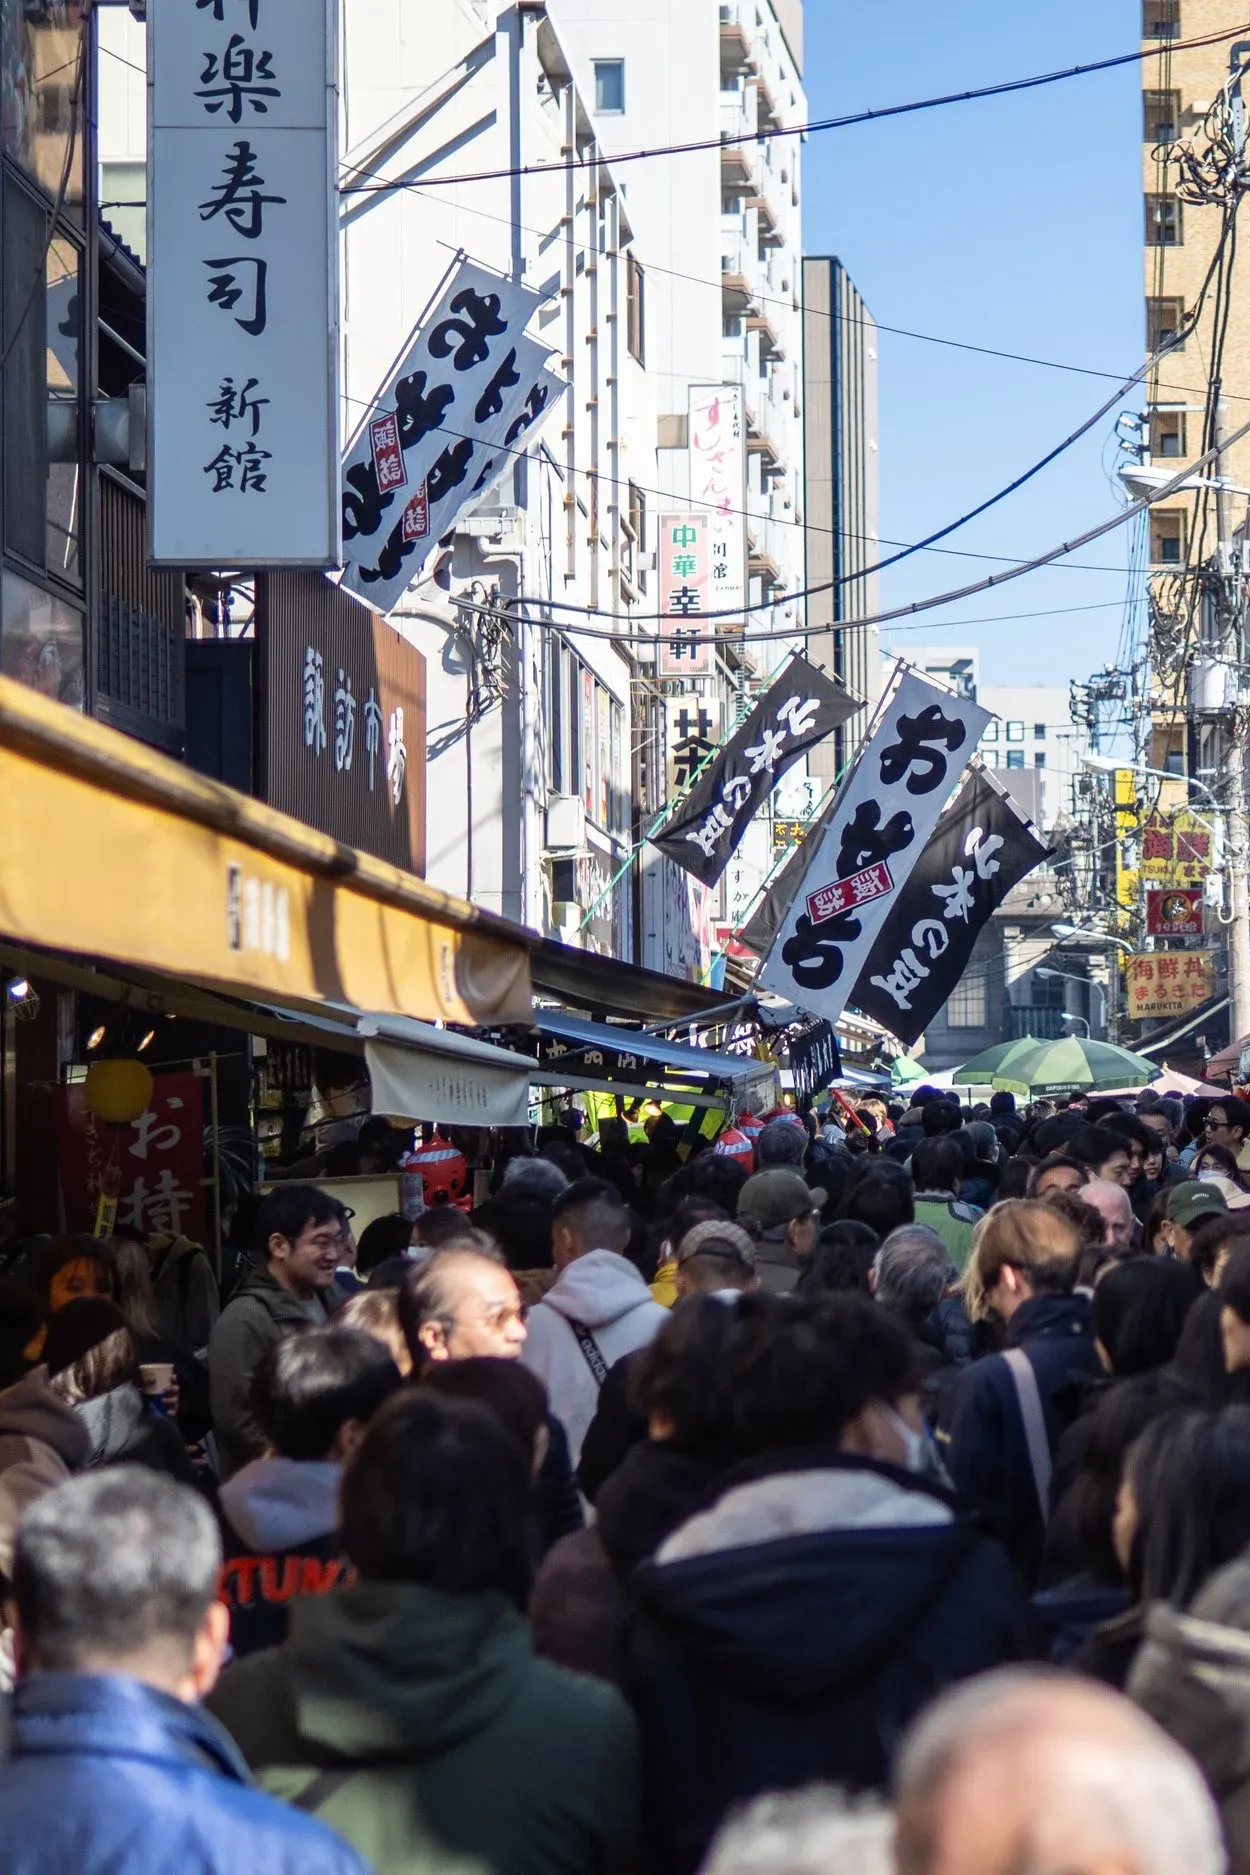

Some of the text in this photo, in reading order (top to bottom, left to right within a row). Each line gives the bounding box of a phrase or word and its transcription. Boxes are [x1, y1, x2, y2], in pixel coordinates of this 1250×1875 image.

[203, 377, 273, 495] 新館
[669, 523, 702, 661] 中華幸軒
[671, 708, 718, 788] 茶
[782, 703, 967, 990] おせち
[1143, 828, 1210, 863] 海鮮
[814, 868, 883, 916] 諏訪
[1132, 956, 1205, 980] 海鮮丼
[1135, 984, 1205, 1000] まるきた
[1136, 1001, 1183, 1011] MARUKITA
